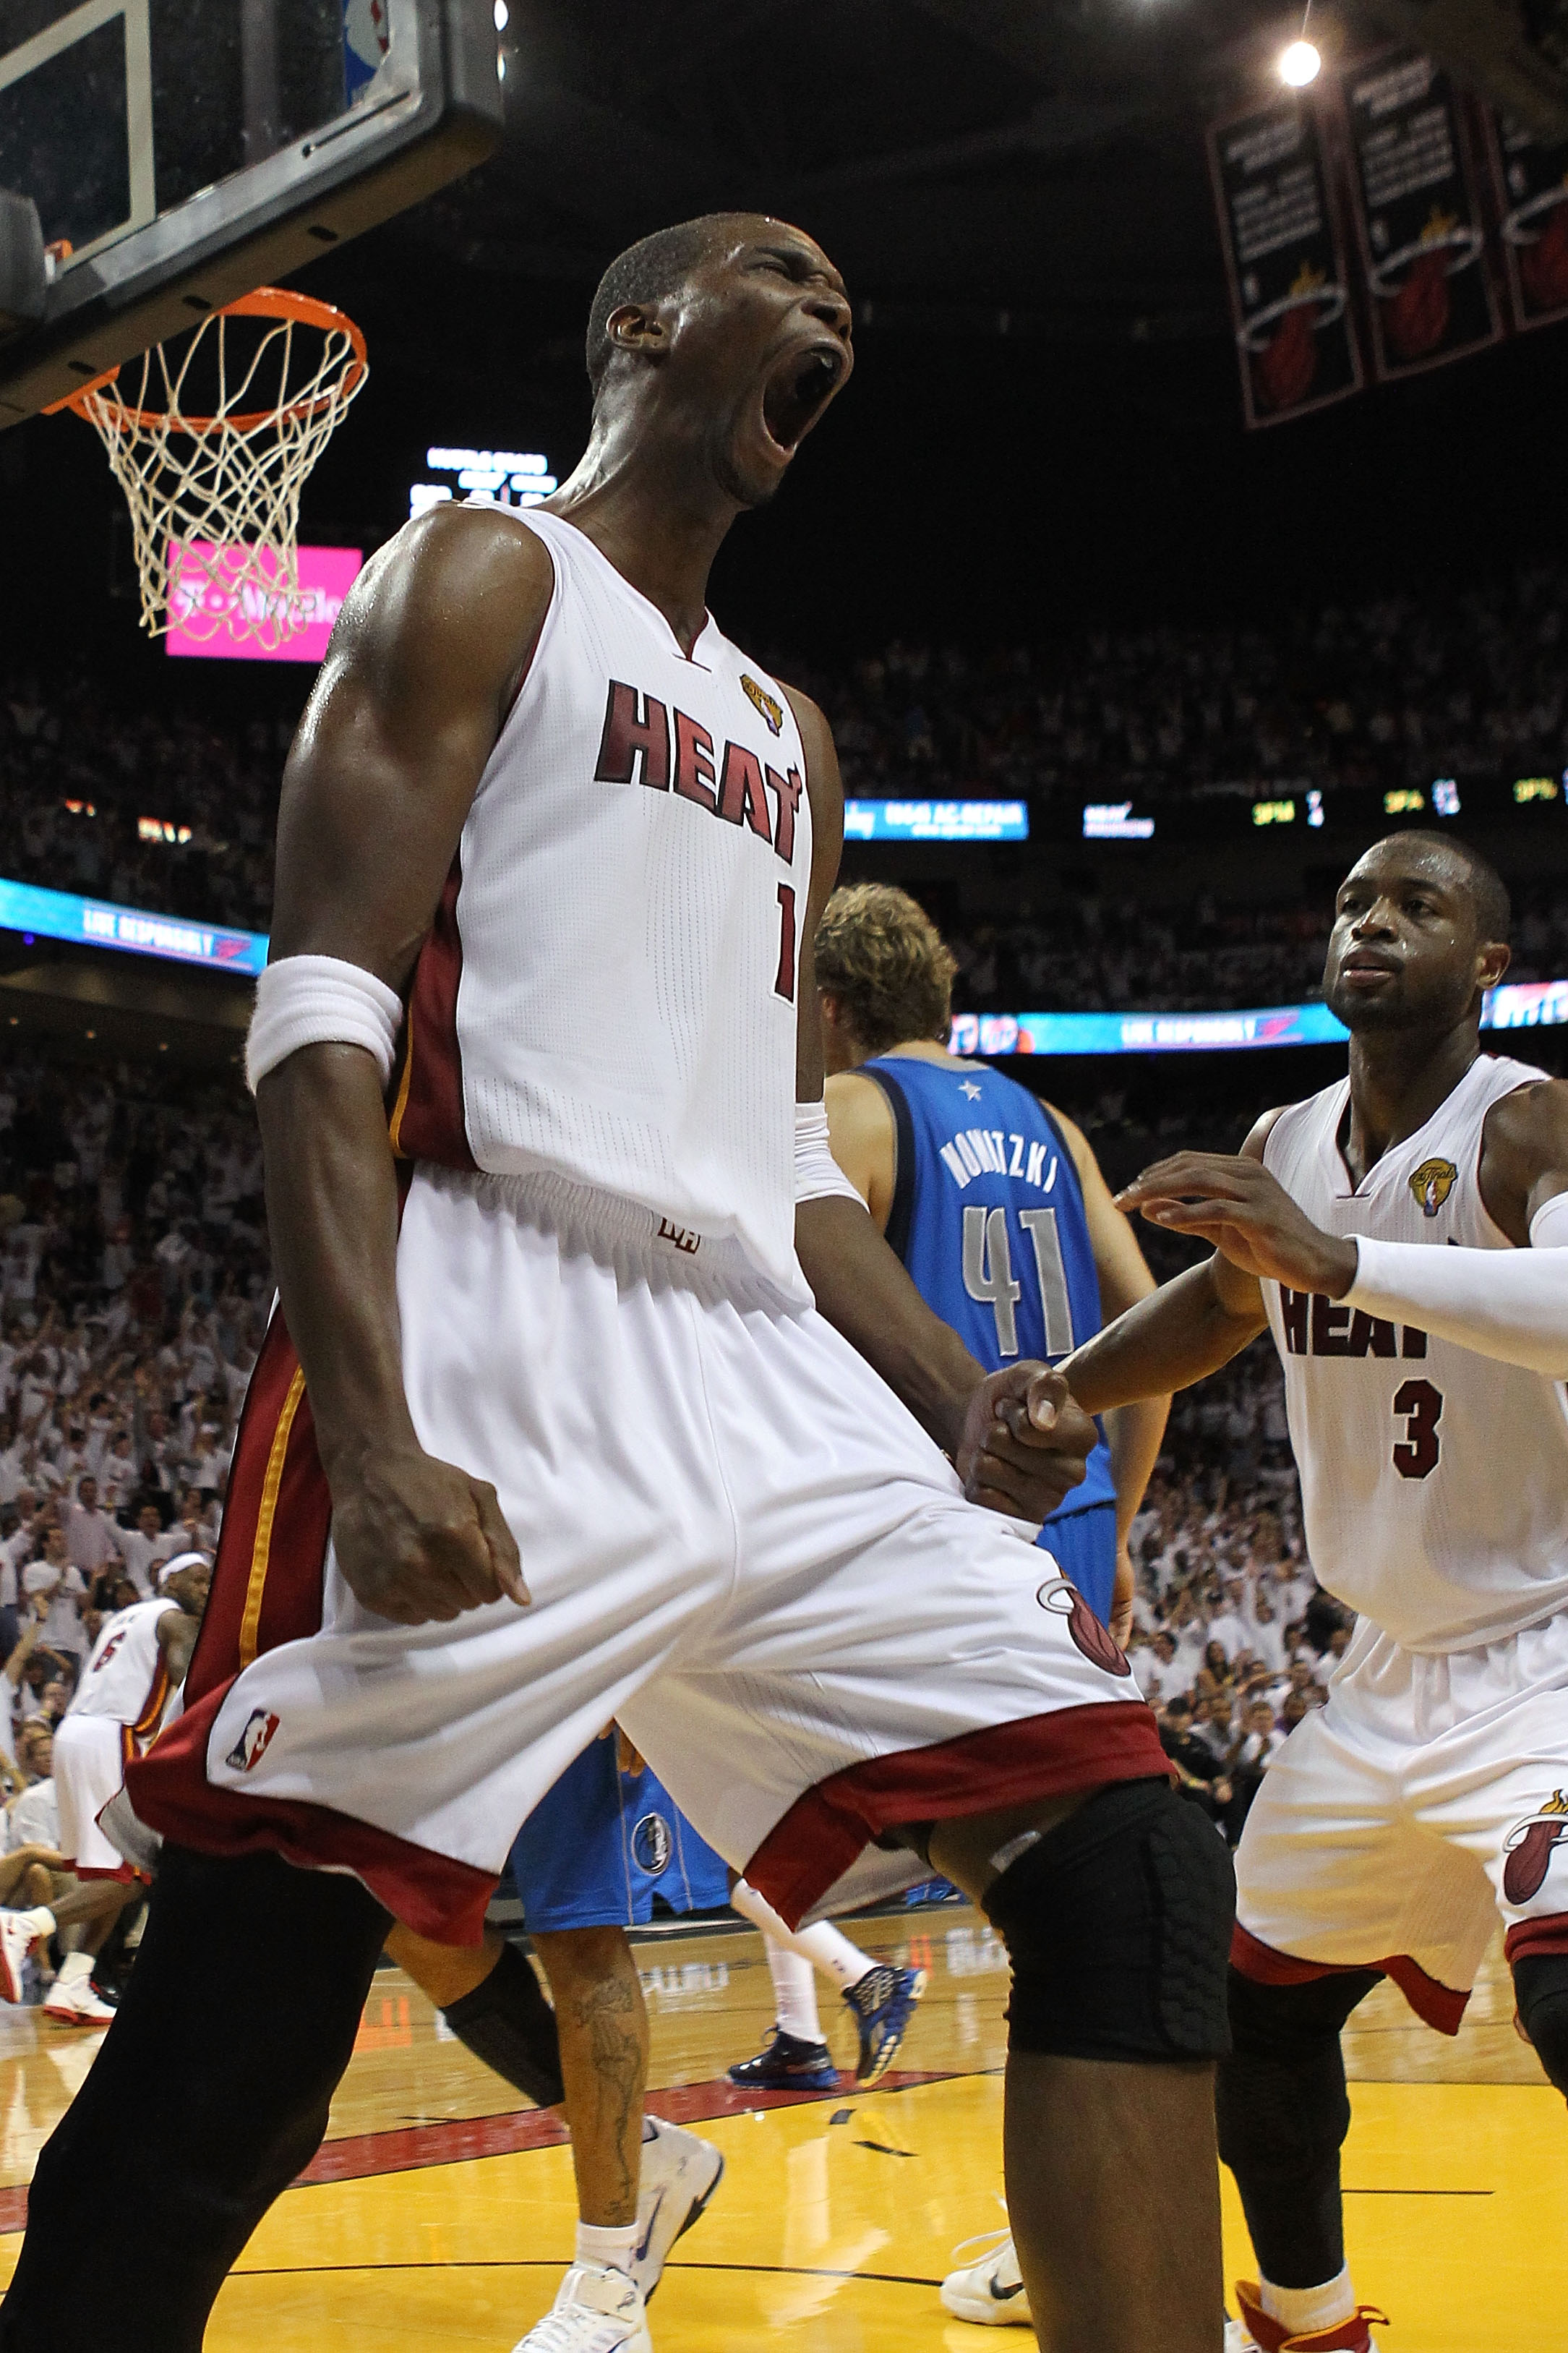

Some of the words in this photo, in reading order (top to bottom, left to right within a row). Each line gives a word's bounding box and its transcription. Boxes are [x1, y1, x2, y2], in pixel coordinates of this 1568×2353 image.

[594, 679, 802, 866] HEAT
[773, 881, 797, 1004] 1
[939, 1128, 1058, 1195] NOWITZKI
[961, 1205, 1075, 1357] 41
[1392, 1378, 1444, 1480] 3
